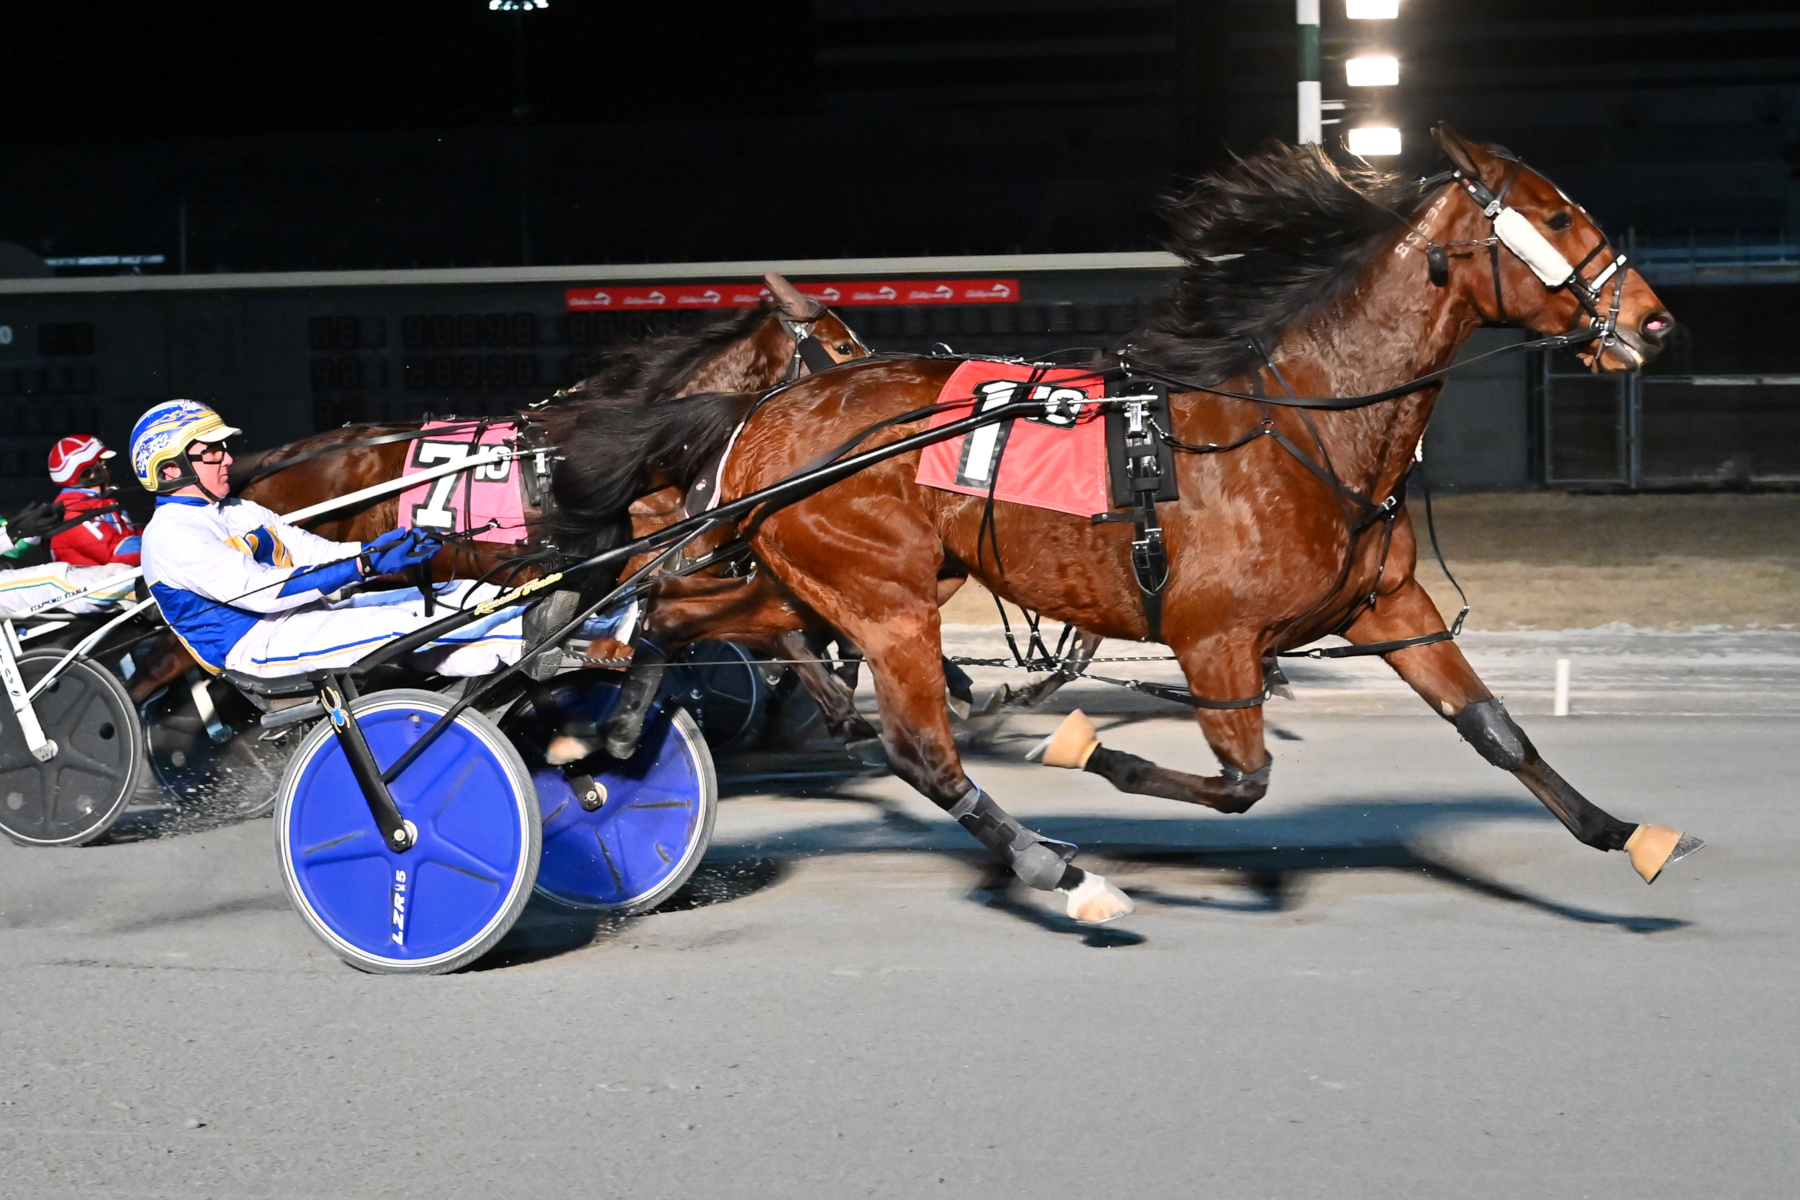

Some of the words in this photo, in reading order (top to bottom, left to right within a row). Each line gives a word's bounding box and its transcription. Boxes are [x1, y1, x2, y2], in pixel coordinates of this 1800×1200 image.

[475, 445, 512, 480] 10
[964, 381, 1018, 482] 1
[417, 442, 470, 529] 7
[392, 893, 405, 945] LZR
